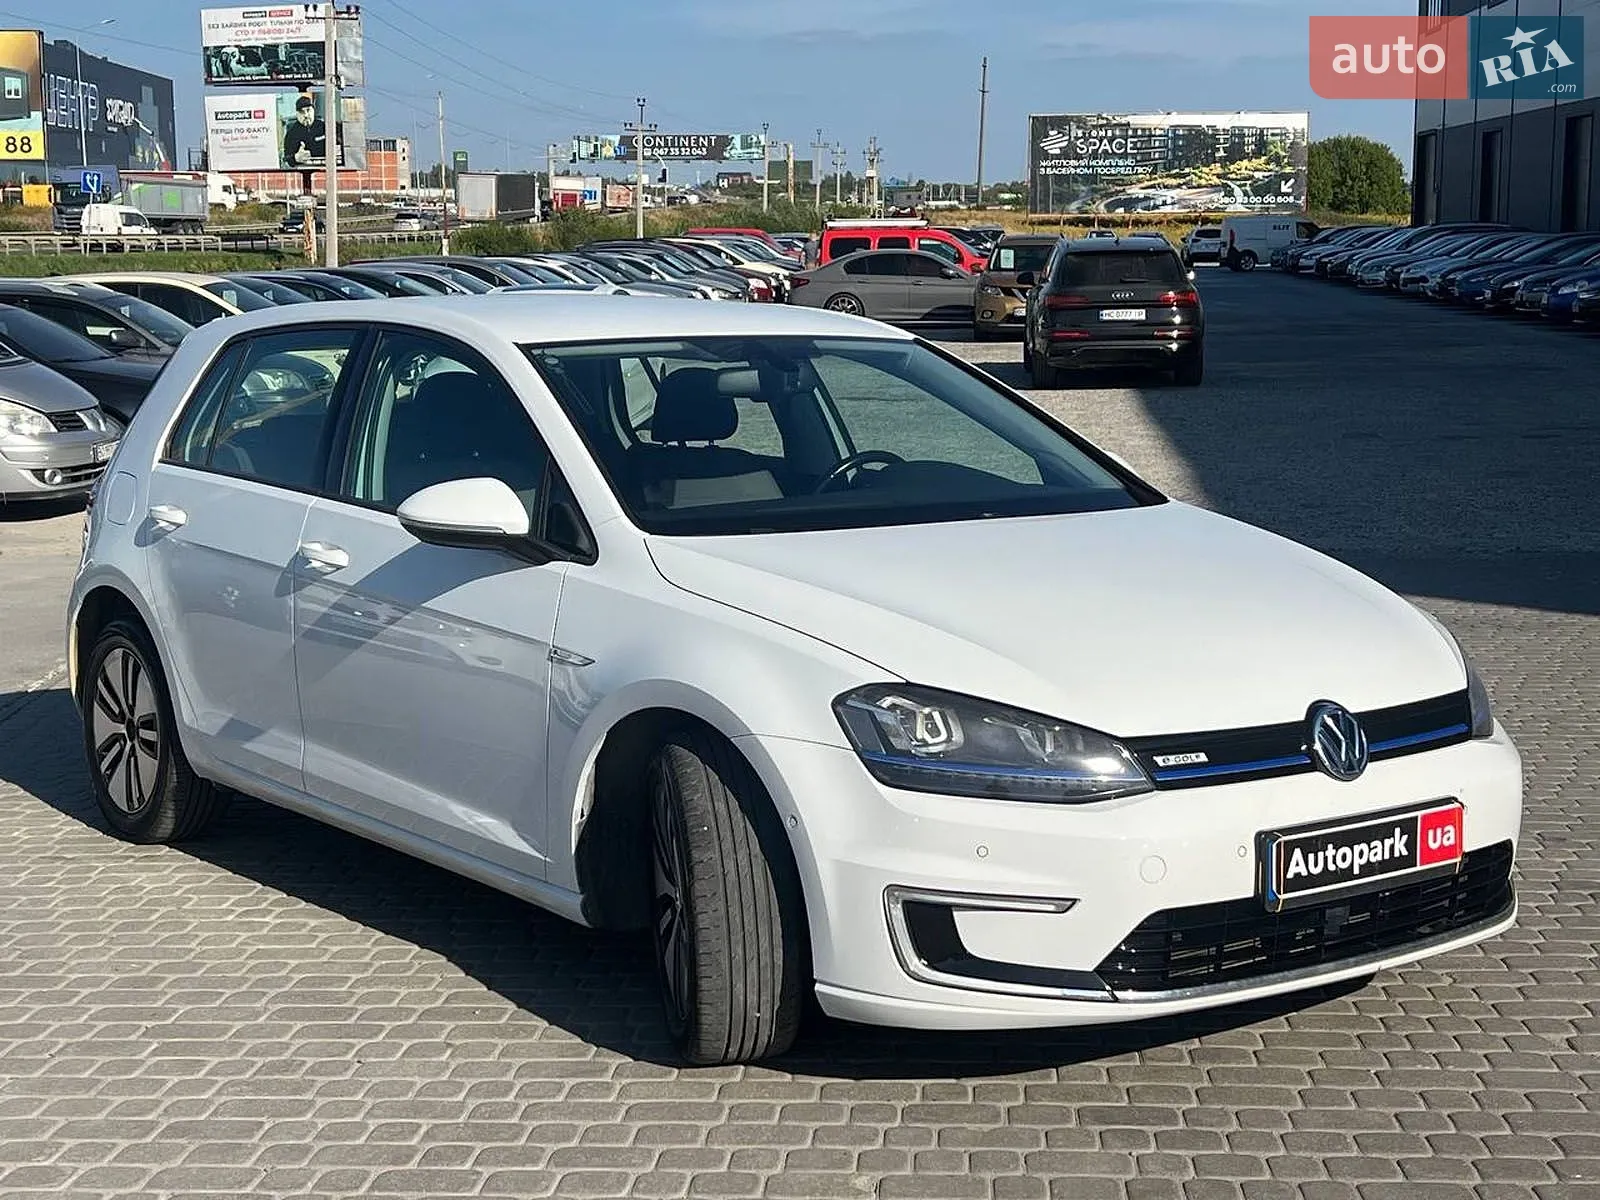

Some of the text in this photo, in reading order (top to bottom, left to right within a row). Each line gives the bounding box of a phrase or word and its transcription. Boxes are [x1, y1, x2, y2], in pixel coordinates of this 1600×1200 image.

[5, 135, 32, 153] 88
[632, 135, 717, 147] CONTINENT
[1076, 138, 1138, 154] SPACE
[1286, 822, 1456, 879] Autopark ua
